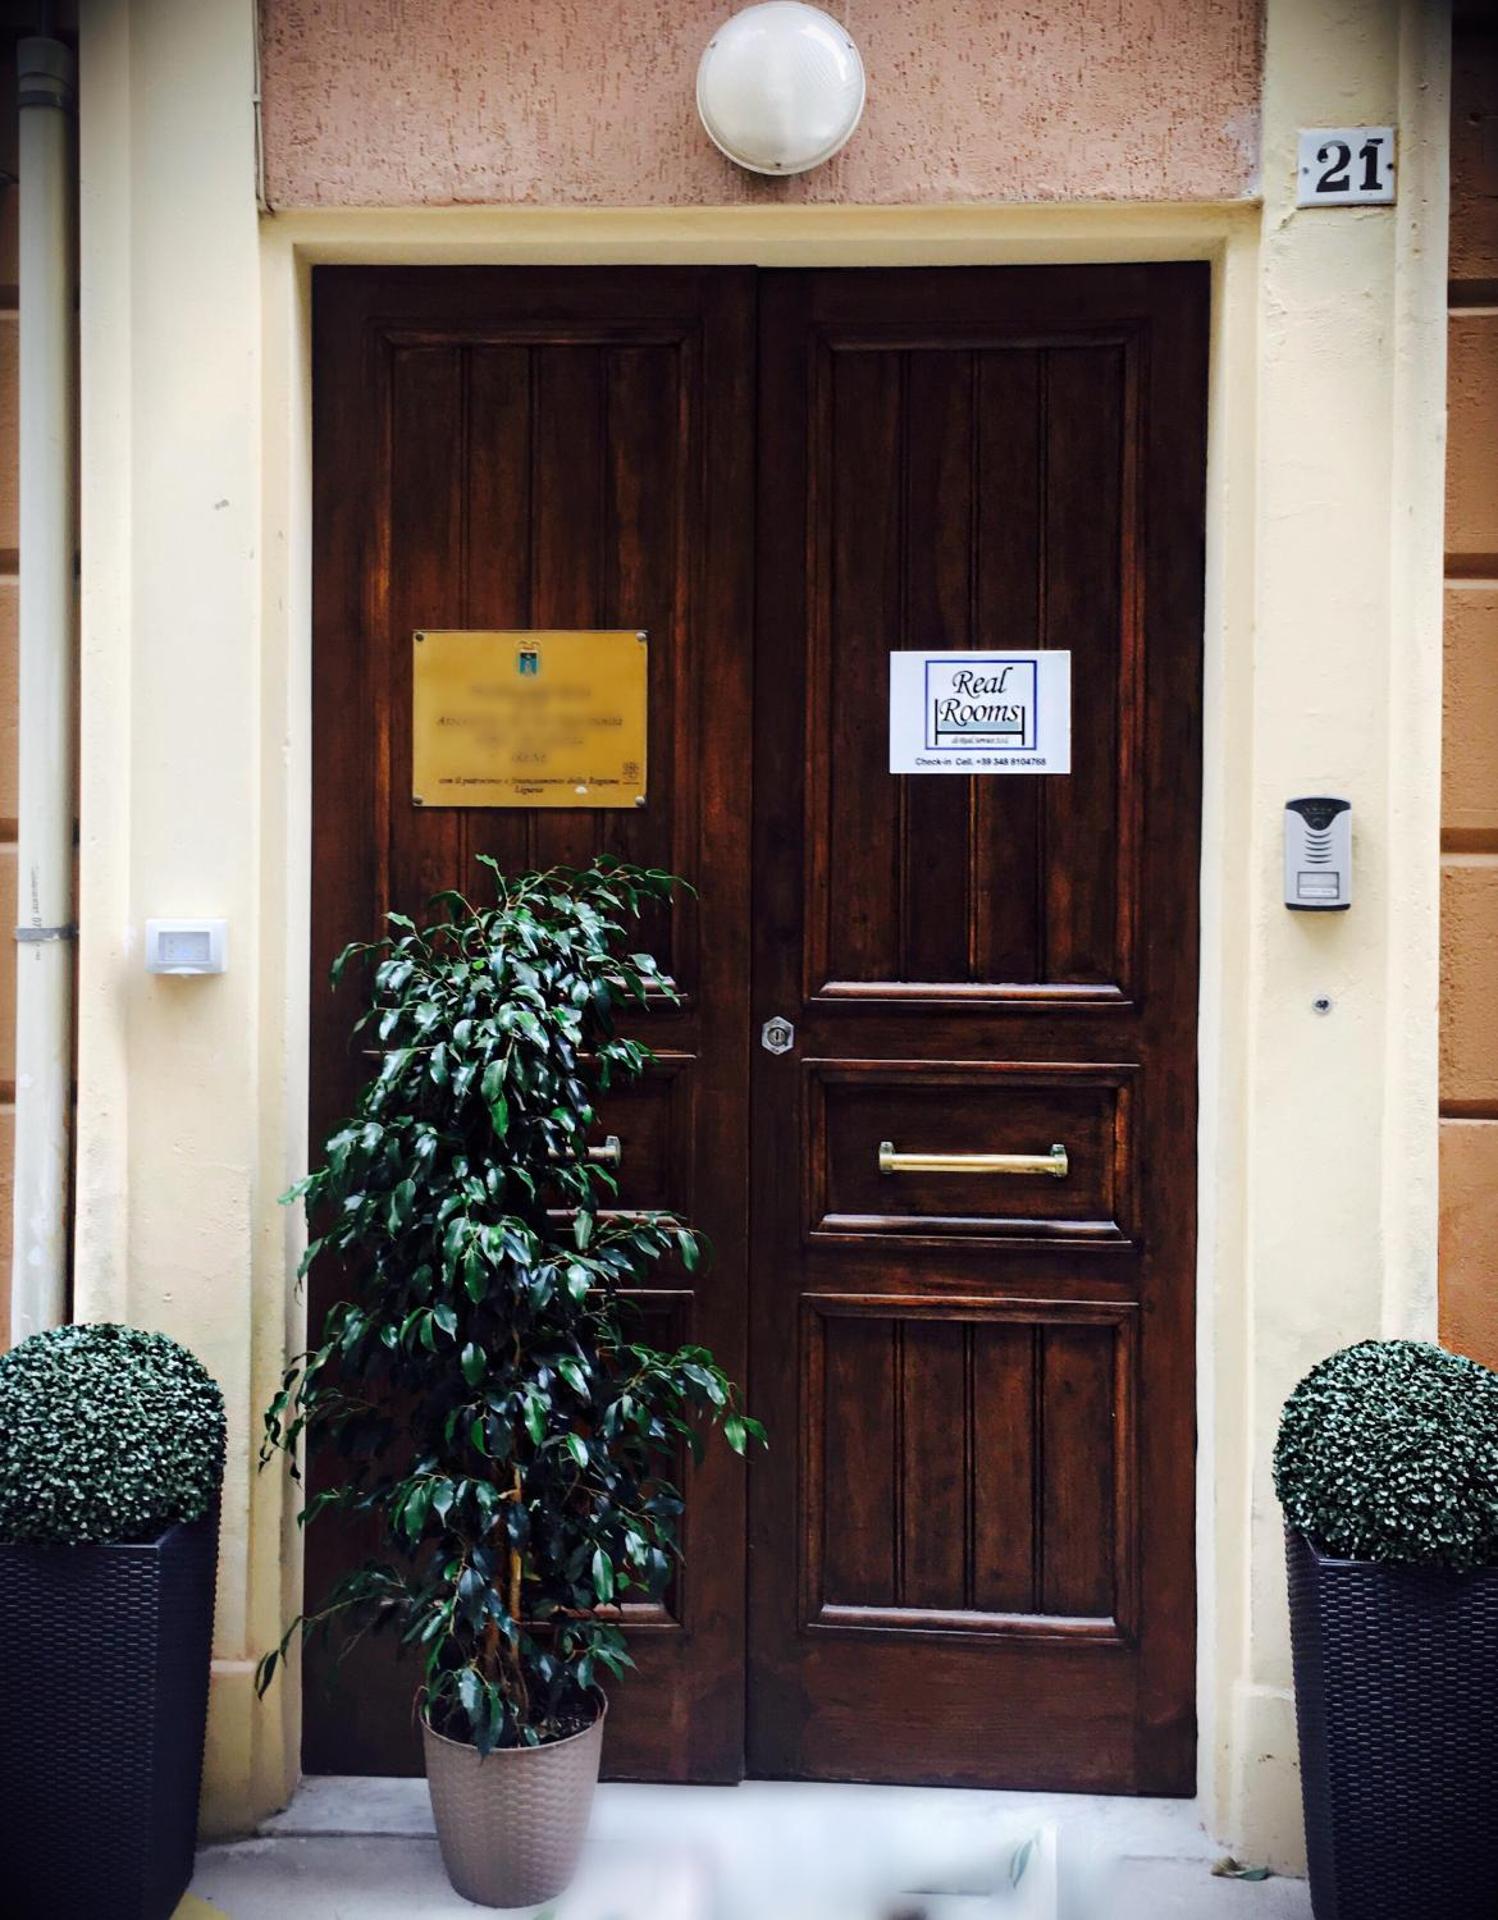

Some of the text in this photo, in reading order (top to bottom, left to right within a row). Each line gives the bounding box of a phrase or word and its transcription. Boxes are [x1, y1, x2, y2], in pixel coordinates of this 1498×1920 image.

[1315, 138, 1384, 193] 21
[952, 667, 1014, 699] Real
[939, 698, 1020, 727] Rooms
[915, 757, 952, 767] Check-in
